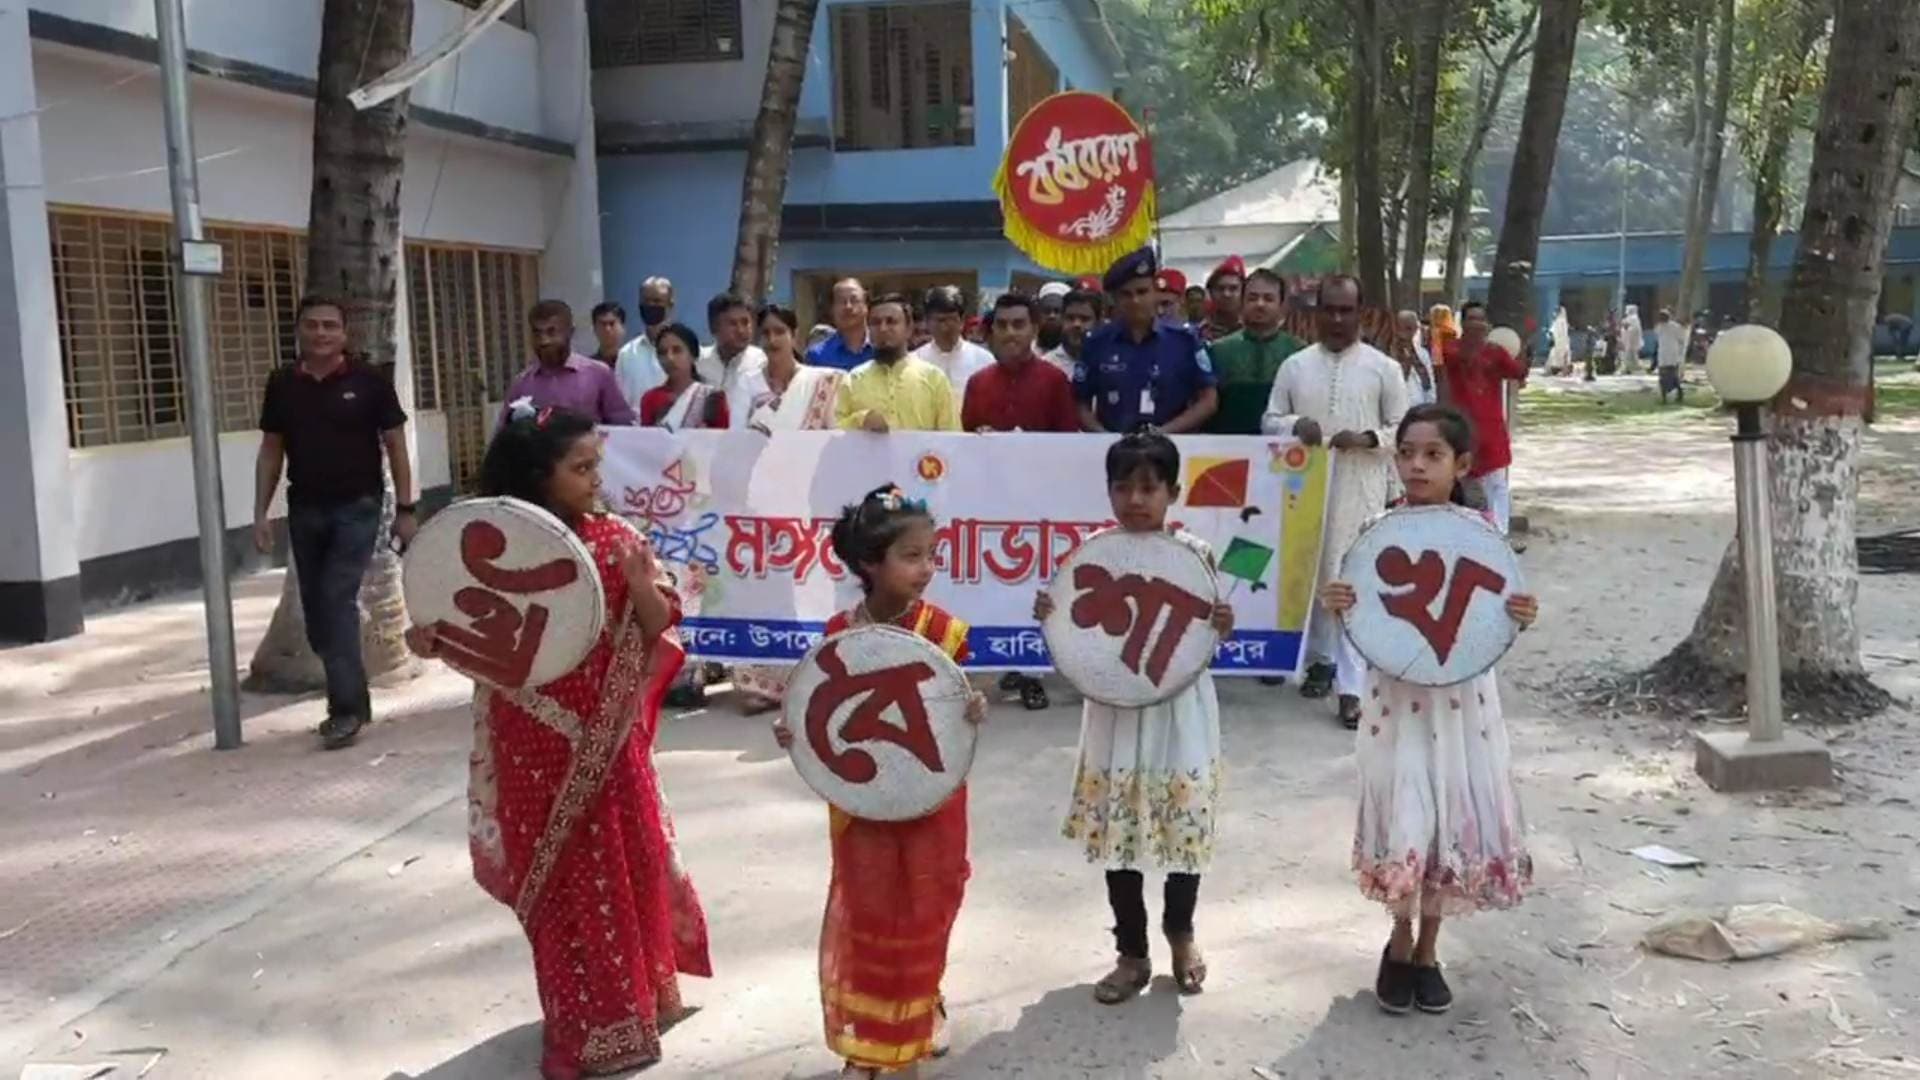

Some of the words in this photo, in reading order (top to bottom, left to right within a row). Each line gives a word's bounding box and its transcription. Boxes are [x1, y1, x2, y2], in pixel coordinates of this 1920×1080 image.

[1016, 126, 1140, 205] বর্ষবরণ
[1070, 562, 1215, 688] শা
[1374, 545, 1507, 667] খ
[806, 639, 946, 785] বৈ
